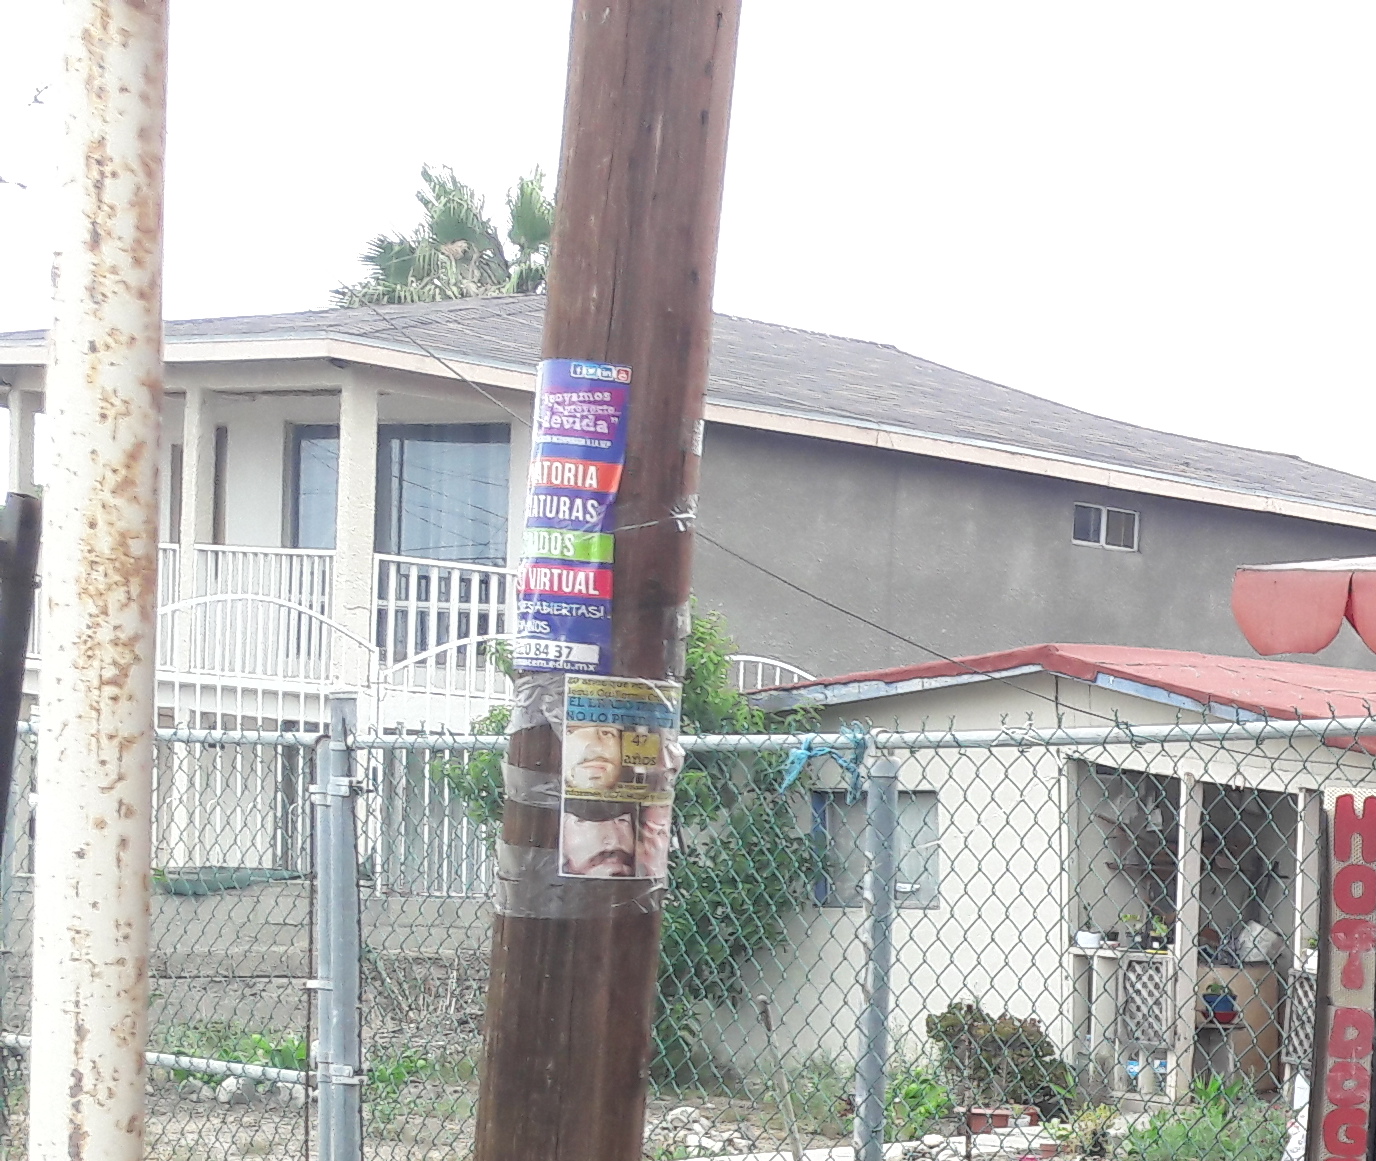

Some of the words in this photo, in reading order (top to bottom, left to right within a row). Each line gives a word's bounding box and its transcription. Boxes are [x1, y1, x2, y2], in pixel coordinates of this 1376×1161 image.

[529, 567, 599, 595] VIRTUAL
[534, 642, 549, 657] 84
[554, 644, 573, 659] 37
[589, 712, 608, 723] LO
[631, 734, 648, 746] 47
[624, 754, 657, 766] años
